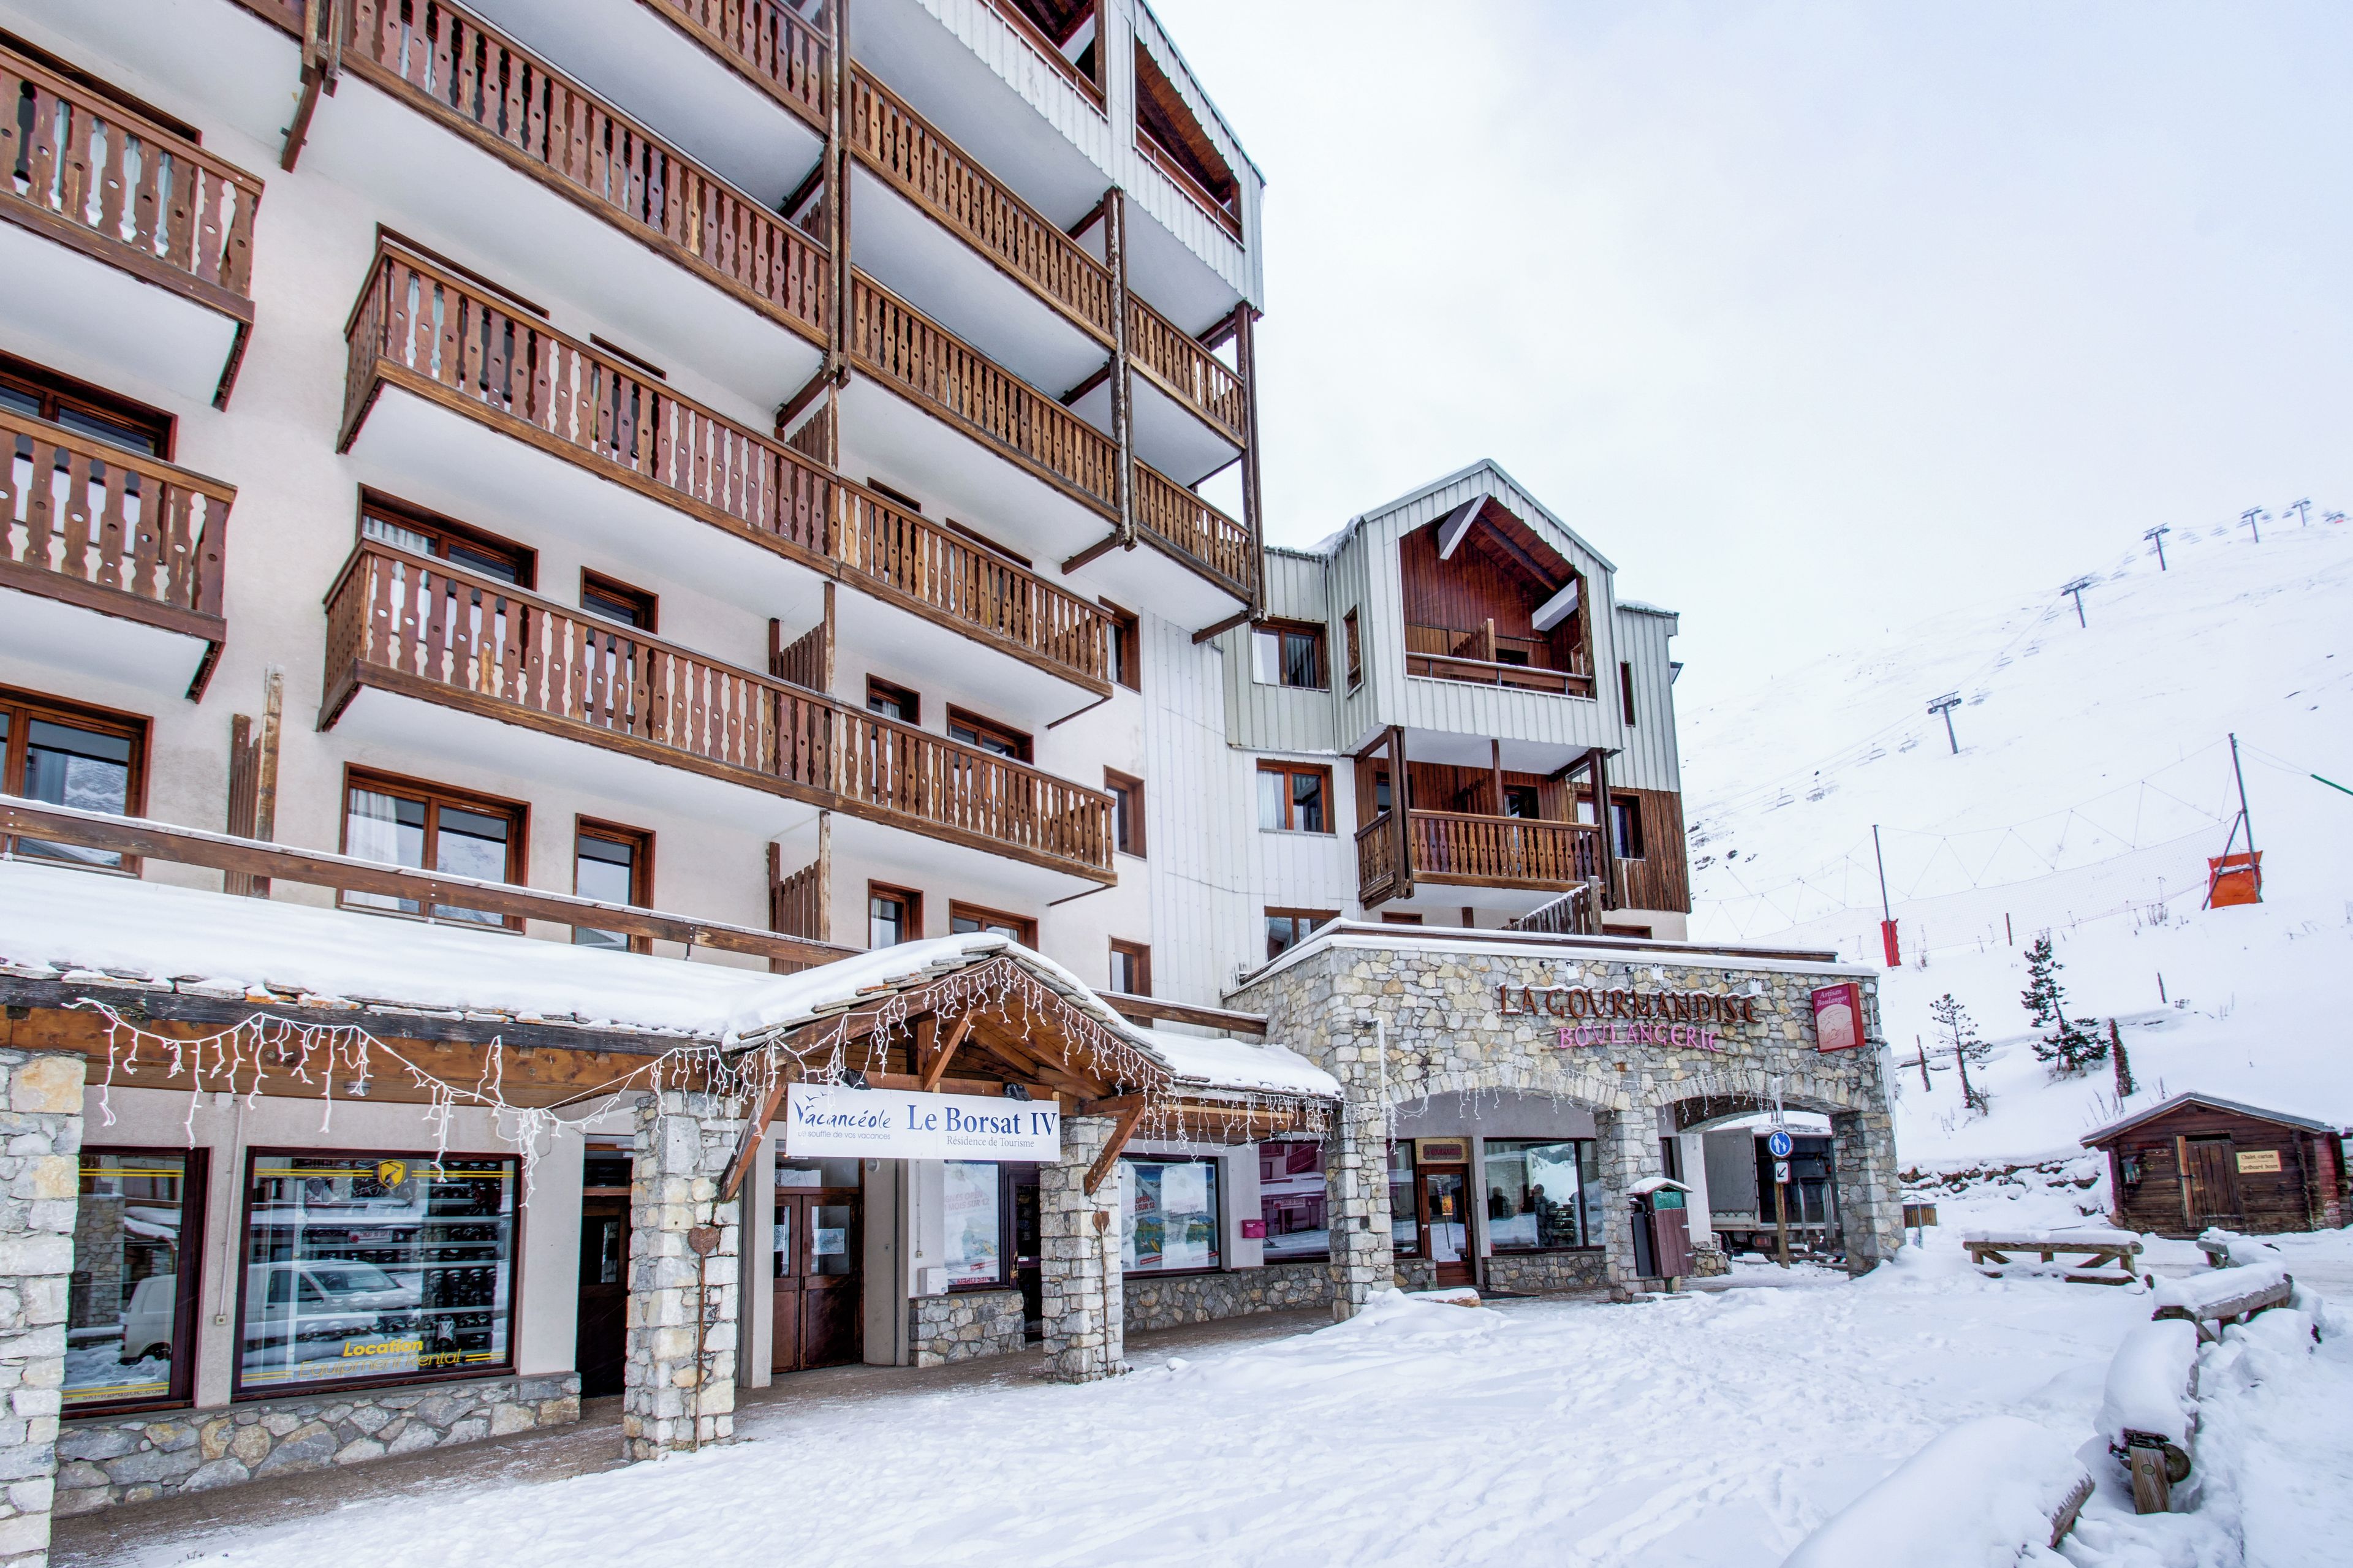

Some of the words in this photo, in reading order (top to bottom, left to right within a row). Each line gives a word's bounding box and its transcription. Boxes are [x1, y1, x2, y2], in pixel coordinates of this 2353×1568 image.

[1820, 989, 1842, 999] Artisan
[1498, 984, 1539, 1016] LA
[1545, 988, 1762, 1024] GOURMANDISE
[1816, 995, 1848, 1007] Boulanger
[1558, 1022, 1724, 1053] BOULANGERIE
[794, 1099, 892, 1129] Vacancéole
[906, 1104, 938, 1131] Le
[944, 1107, 1021, 1134] Borsat
[1030, 1112, 1058, 1135] IV
[947, 1135, 986, 1147] Résidence
[988, 1137, 998, 1147] de
[999, 1137, 1034, 1148] Tourisme
[964, 1191, 983, 1200] OPEN
[1135, 1195, 1150, 1204] OPEN
[949, 1201, 966, 1211] MOIS
[967, 1199, 980, 1208] SUR
[1138, 1203, 1148, 1211] SUR
[343, 1338, 423, 1357] Location
[298, 1357, 402, 1377] Equipment
[406, 1349, 461, 1368] Rental
